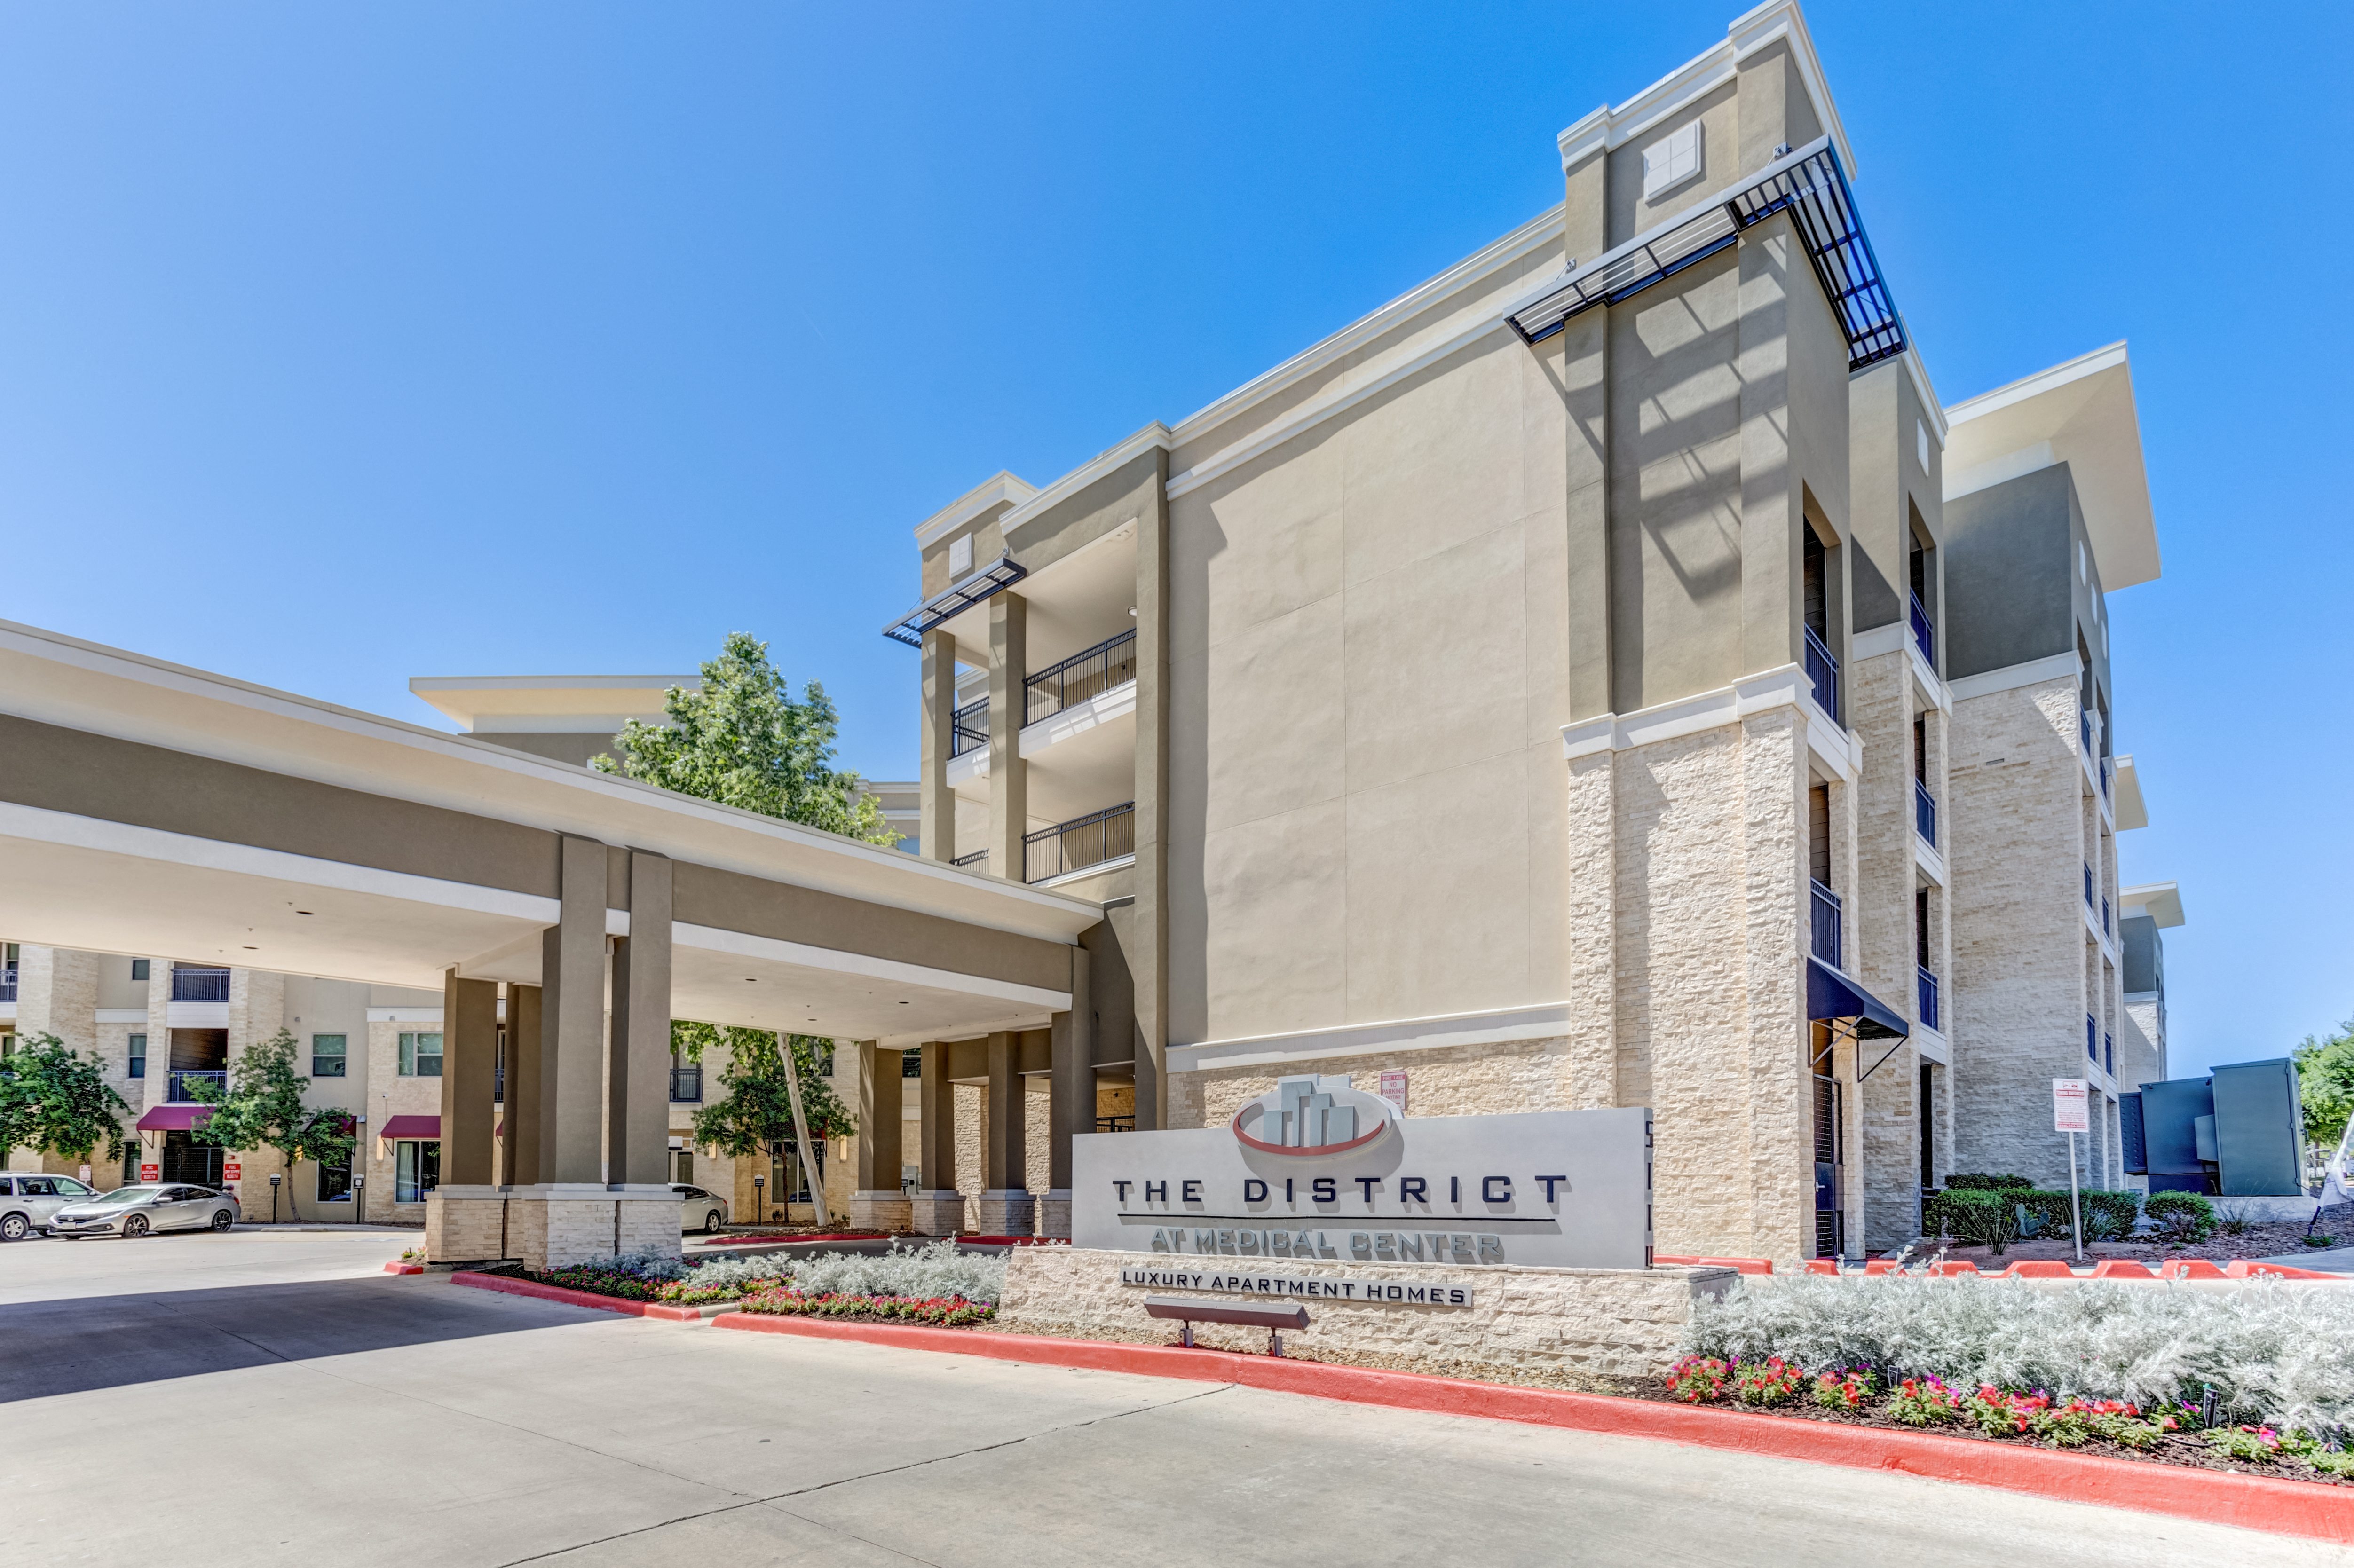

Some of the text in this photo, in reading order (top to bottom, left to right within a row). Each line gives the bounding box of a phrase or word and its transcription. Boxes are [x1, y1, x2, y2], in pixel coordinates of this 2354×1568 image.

[1113, 1175, 1566, 1203] THE DISTRICT
[1151, 1228, 1501, 1256] AT MEDICAL CENTER
[1123, 1271, 1464, 1303] LUXURY APARTMENT HOMES
